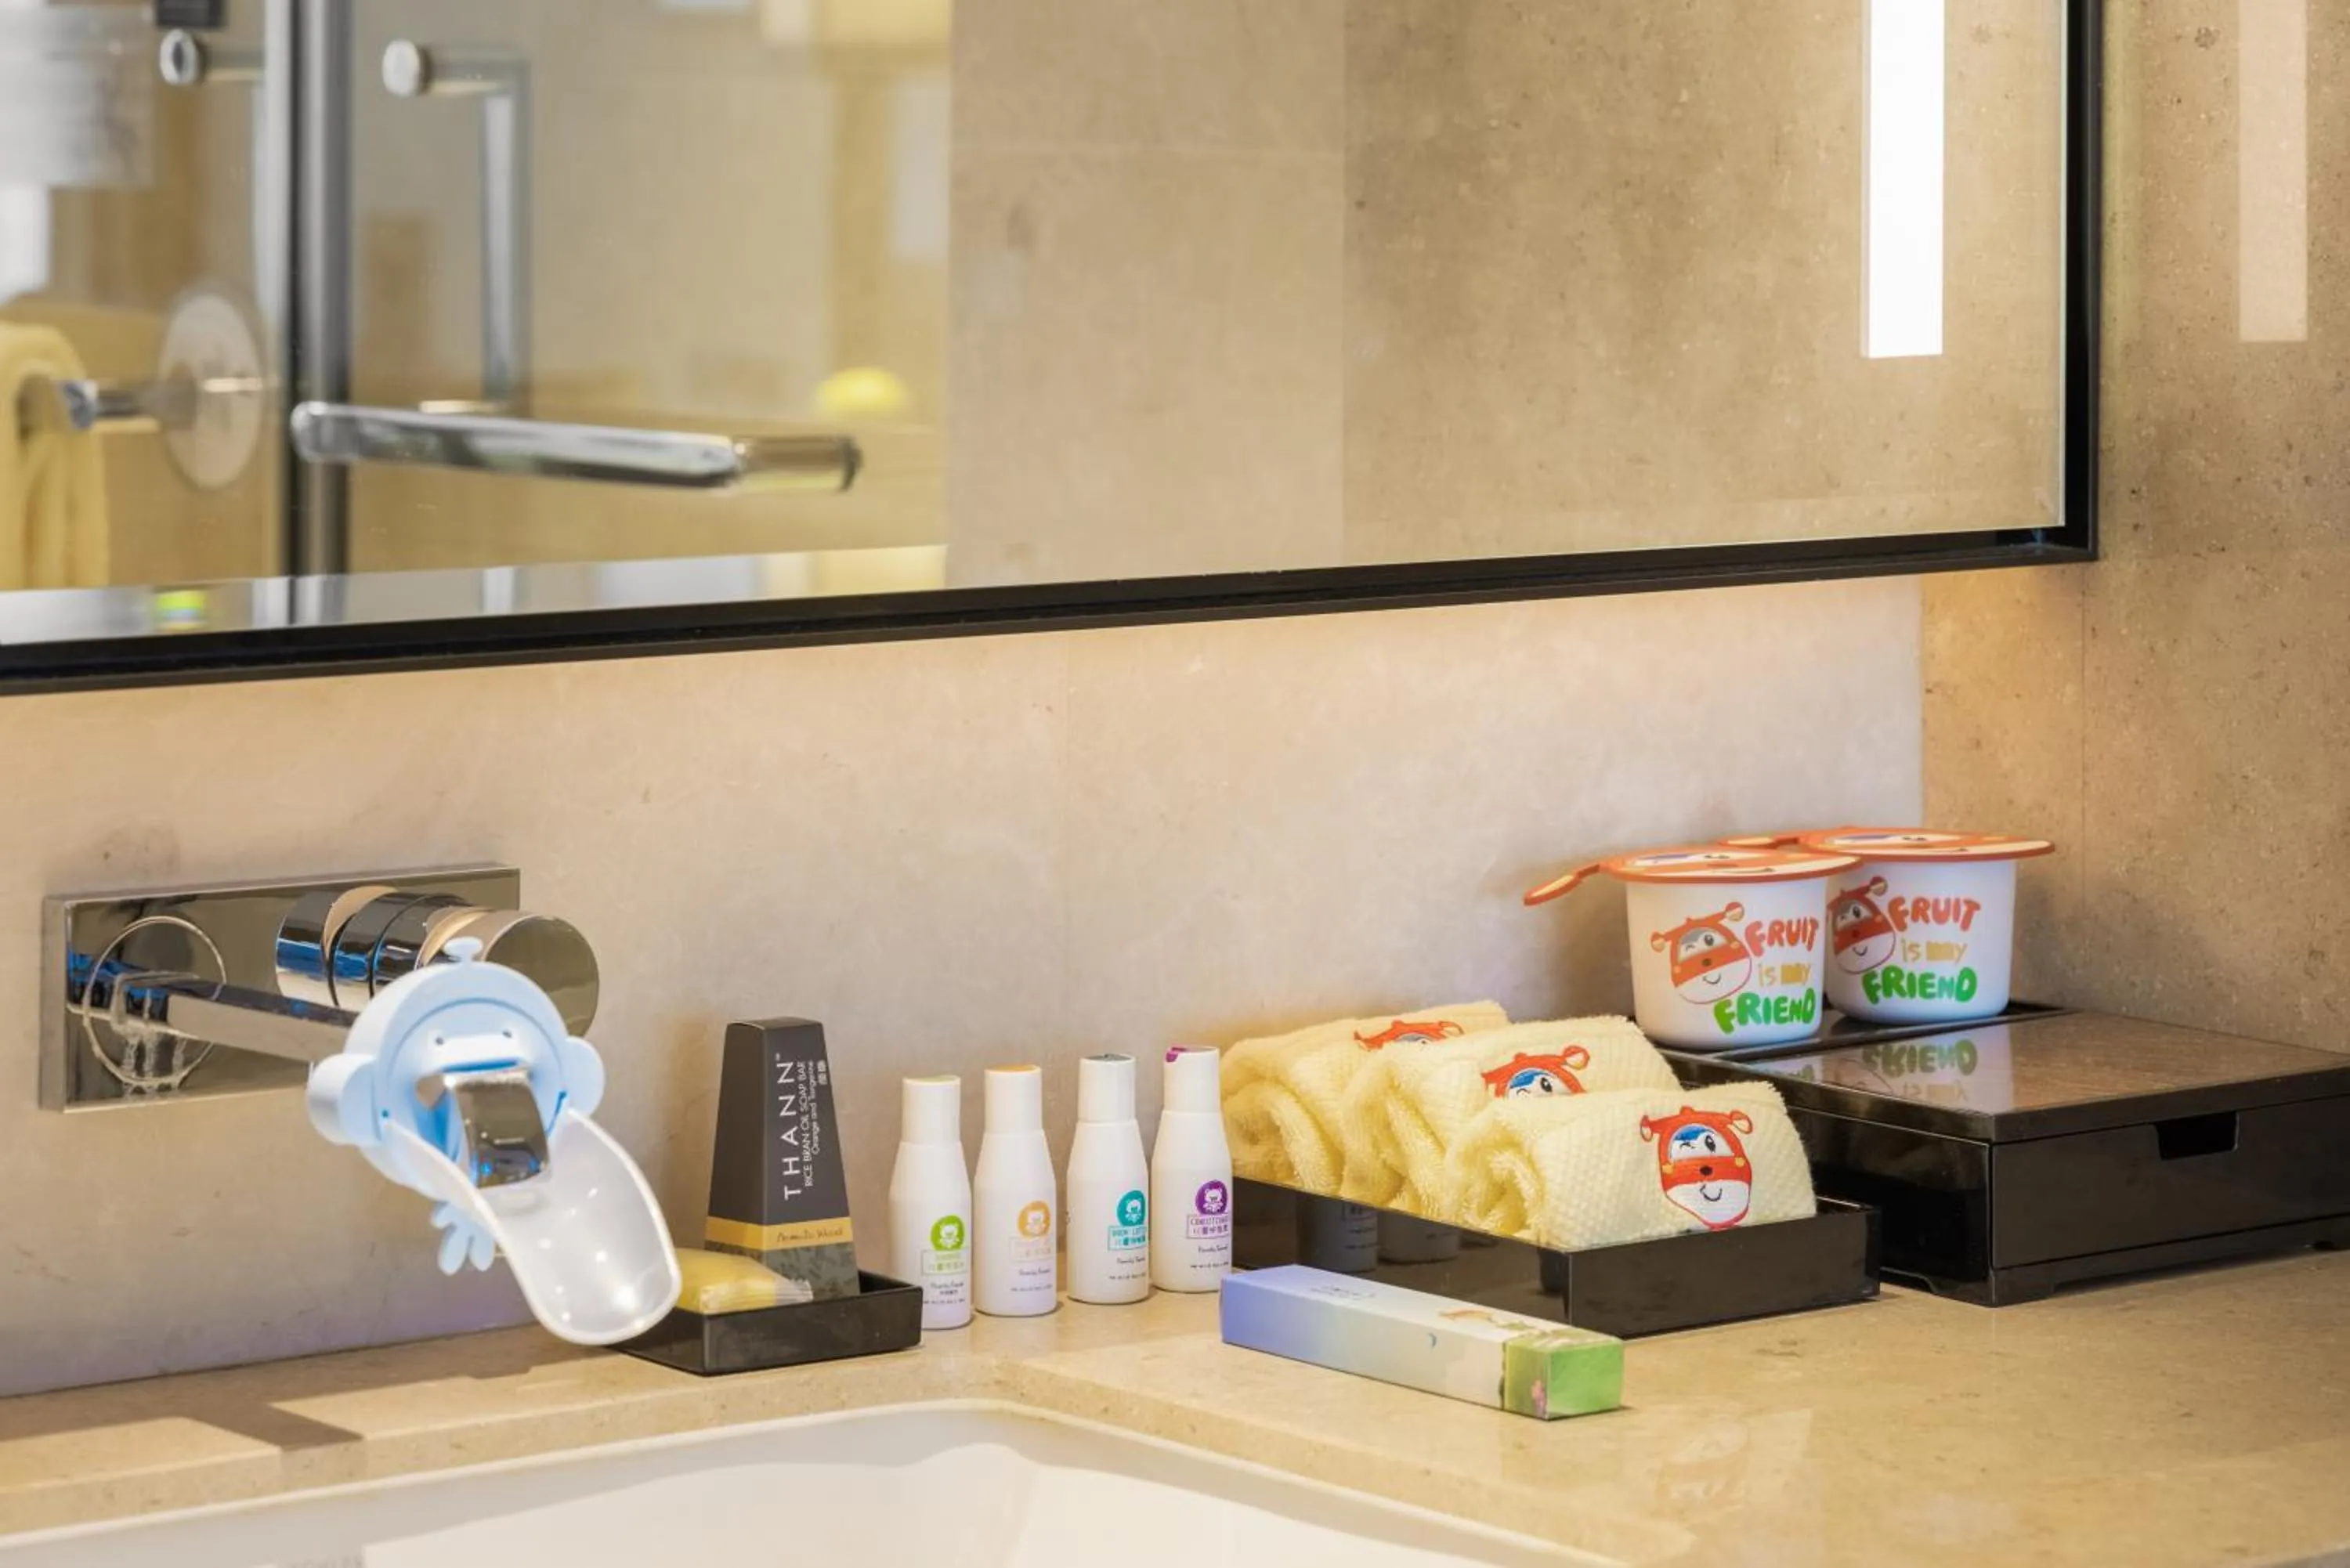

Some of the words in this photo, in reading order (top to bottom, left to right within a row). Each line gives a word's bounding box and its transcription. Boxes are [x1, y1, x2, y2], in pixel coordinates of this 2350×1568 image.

[1888, 895, 1981, 932] FRUIT
[1744, 916, 1819, 957] FRUIT
[1861, 965, 1978, 1006] FRIEND
[1713, 988, 1817, 1035] FRIEND
[797, 1060, 807, 1081] BAR
[798, 1083, 809, 1112] SOAP
[776, 1061, 801, 1201] THANN
[800, 1115, 810, 1131] OIL
[801, 1133, 812, 1162] BRAN
[803, 1165, 814, 1187] RICE
